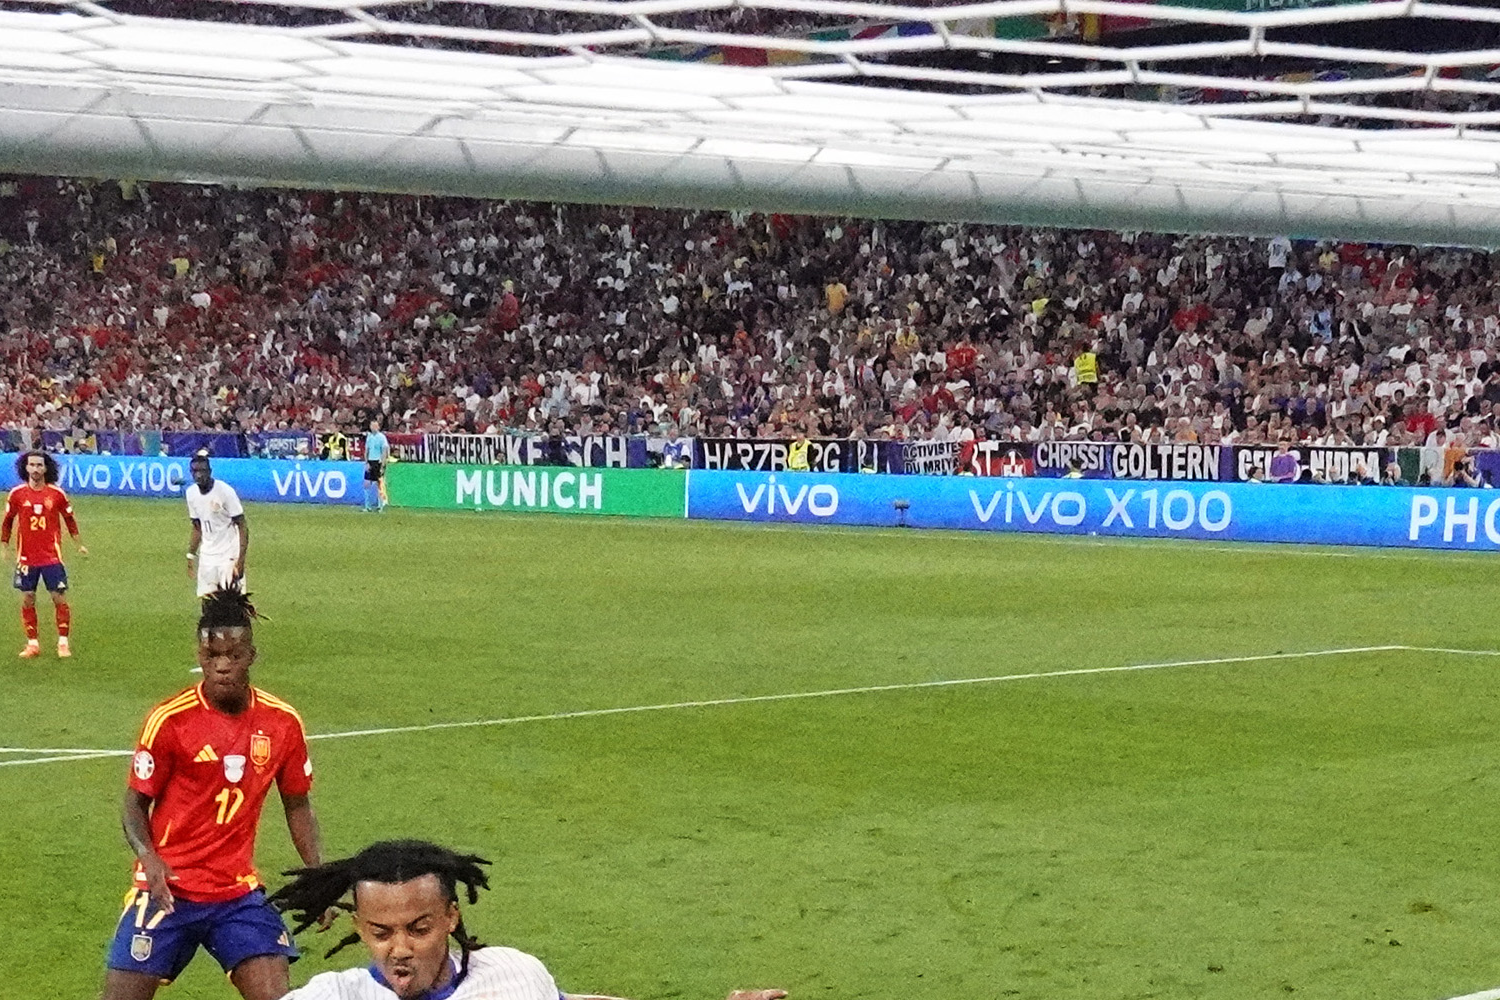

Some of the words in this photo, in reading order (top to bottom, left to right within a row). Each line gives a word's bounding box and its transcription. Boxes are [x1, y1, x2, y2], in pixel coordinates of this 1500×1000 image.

[272, 464, 346, 498] vivo
[1112, 444, 1220, 480] GOLTERN
[456, 469, 602, 509] MUNICH
[736, 475, 839, 516] vivo
[969, 481, 1087, 526] vivo
[1102, 488, 1232, 532] X100
[30, 515, 46, 531] 24
[214, 787, 245, 825] 17
